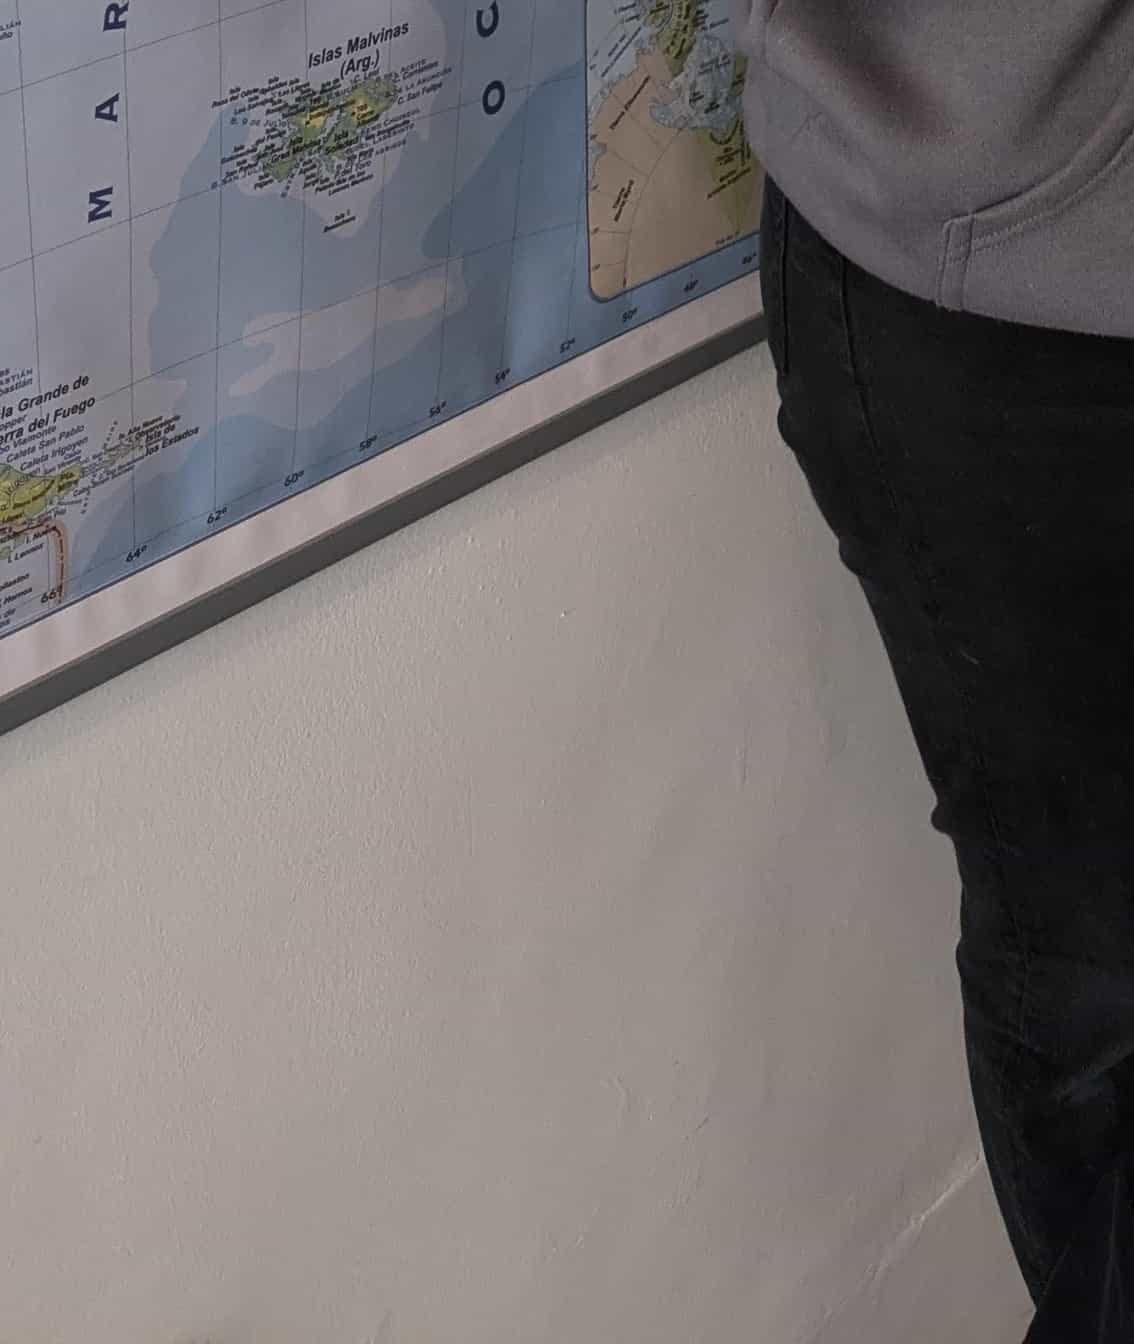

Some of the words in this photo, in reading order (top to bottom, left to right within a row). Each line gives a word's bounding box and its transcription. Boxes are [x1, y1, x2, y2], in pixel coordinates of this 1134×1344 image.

[308, 43, 342, 69] Islas
[346, 21, 409, 55] Malvinas
[340, 49, 380, 80] (Arg.)
[88, 0, 129, 223] MAR
[18, 384, 69, 412] Grande
[72, 375, 90, 390] de
[28, 416, 50, 433] del
[53, 395, 96, 426] Fuego
